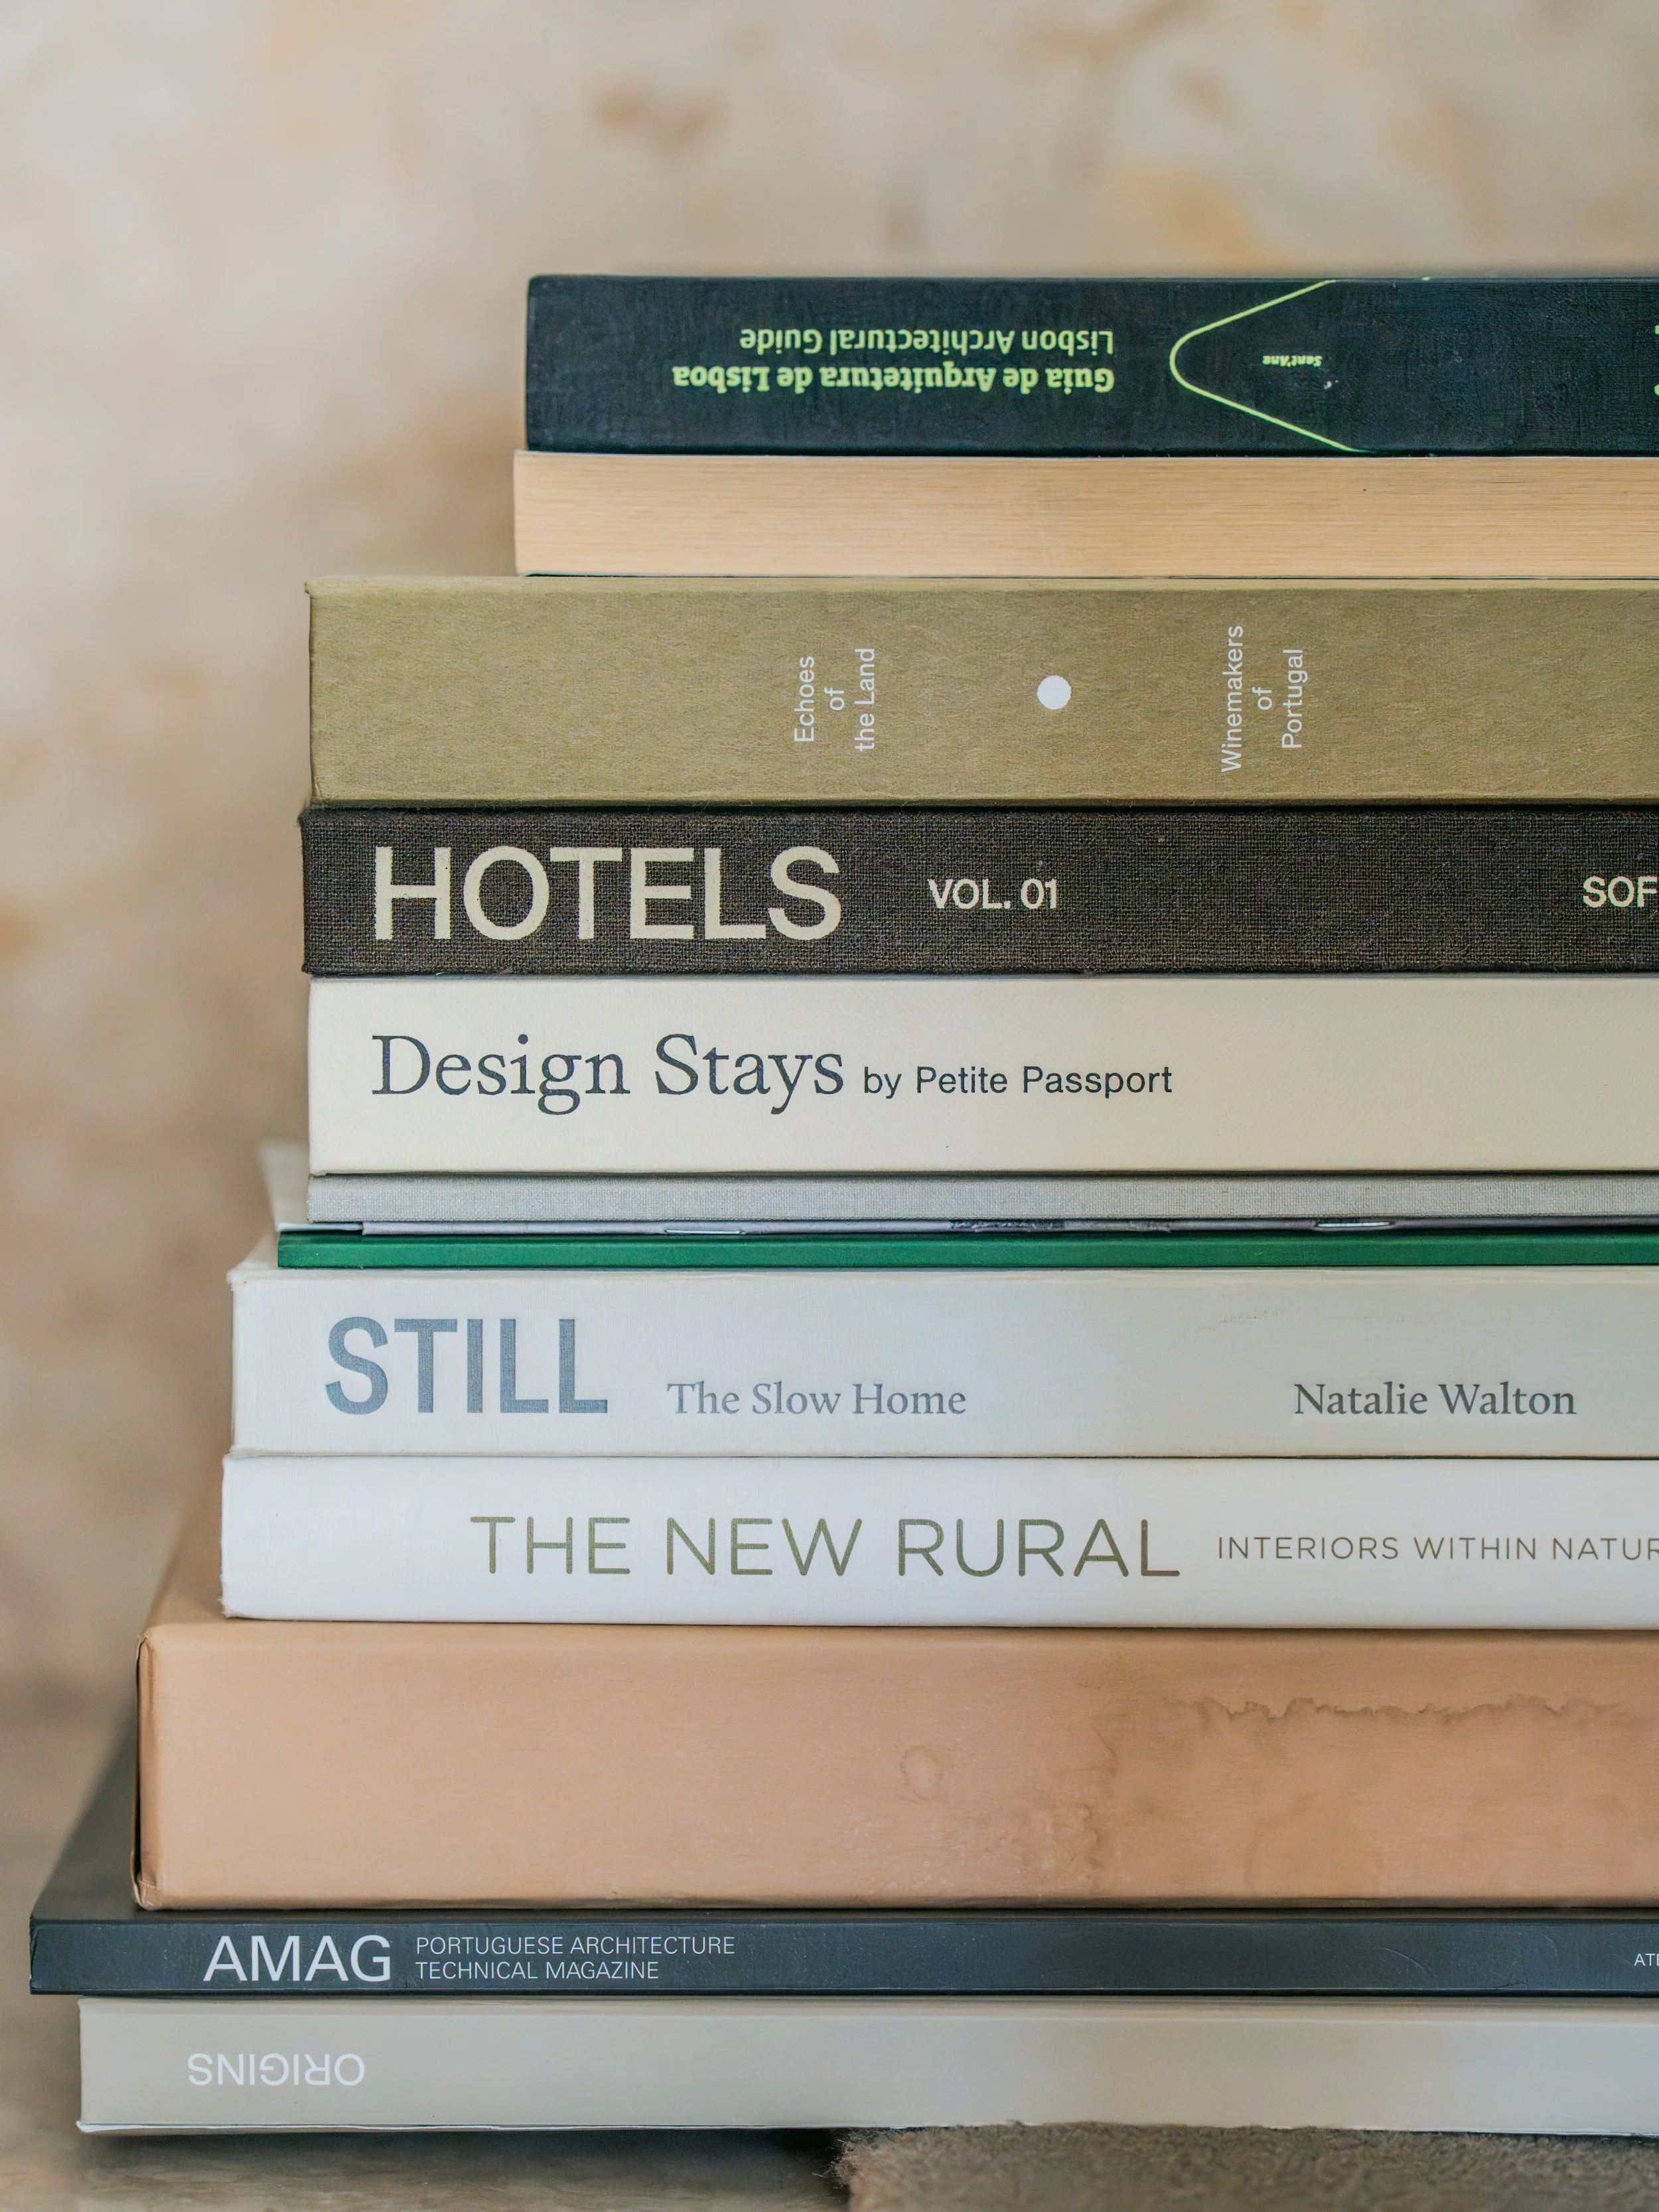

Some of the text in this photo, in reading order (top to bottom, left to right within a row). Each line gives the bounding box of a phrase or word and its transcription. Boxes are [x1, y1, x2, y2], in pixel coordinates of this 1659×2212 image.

[740, 329, 1113, 356] Lisbon Architectural Guide
[672, 361, 1114, 394] Guia de Arquitetura de Lisboa
[794, 656, 814, 741] Echoes
[824, 688, 845, 710] of
[855, 649, 875, 751] the Land
[1222, 626, 1243, 772] Winemakers
[1252, 687, 1272, 709] of
[1281, 650, 1308, 748] Portugal
[375, 846, 841, 940] HOTELS
[928, 879, 1056, 909] VOL. 01
[1583, 876, 1657, 907] SOF
[372, 1034, 1172, 1115] Design Stays by Petite Passport
[325, 1317, 608, 1414] STILL
[668, 1380, 966, 1414] The Slow Home
[1295, 1381, 1576, 1414] Natalie Walton
[470, 1516, 1180, 1577] THE NEW RURAL
[1219, 1537, 1659, 1560] INTERIORS WITHIN NATUR
[204, 1935, 390, 1982] AMAG
[417, 1937, 734, 1954] PORTUGUESE ARCHITECTURE
[415, 1961, 658, 1979] TECHNICAL MAGAZINE
[188, 2053, 364, 2085] ORIGINS
